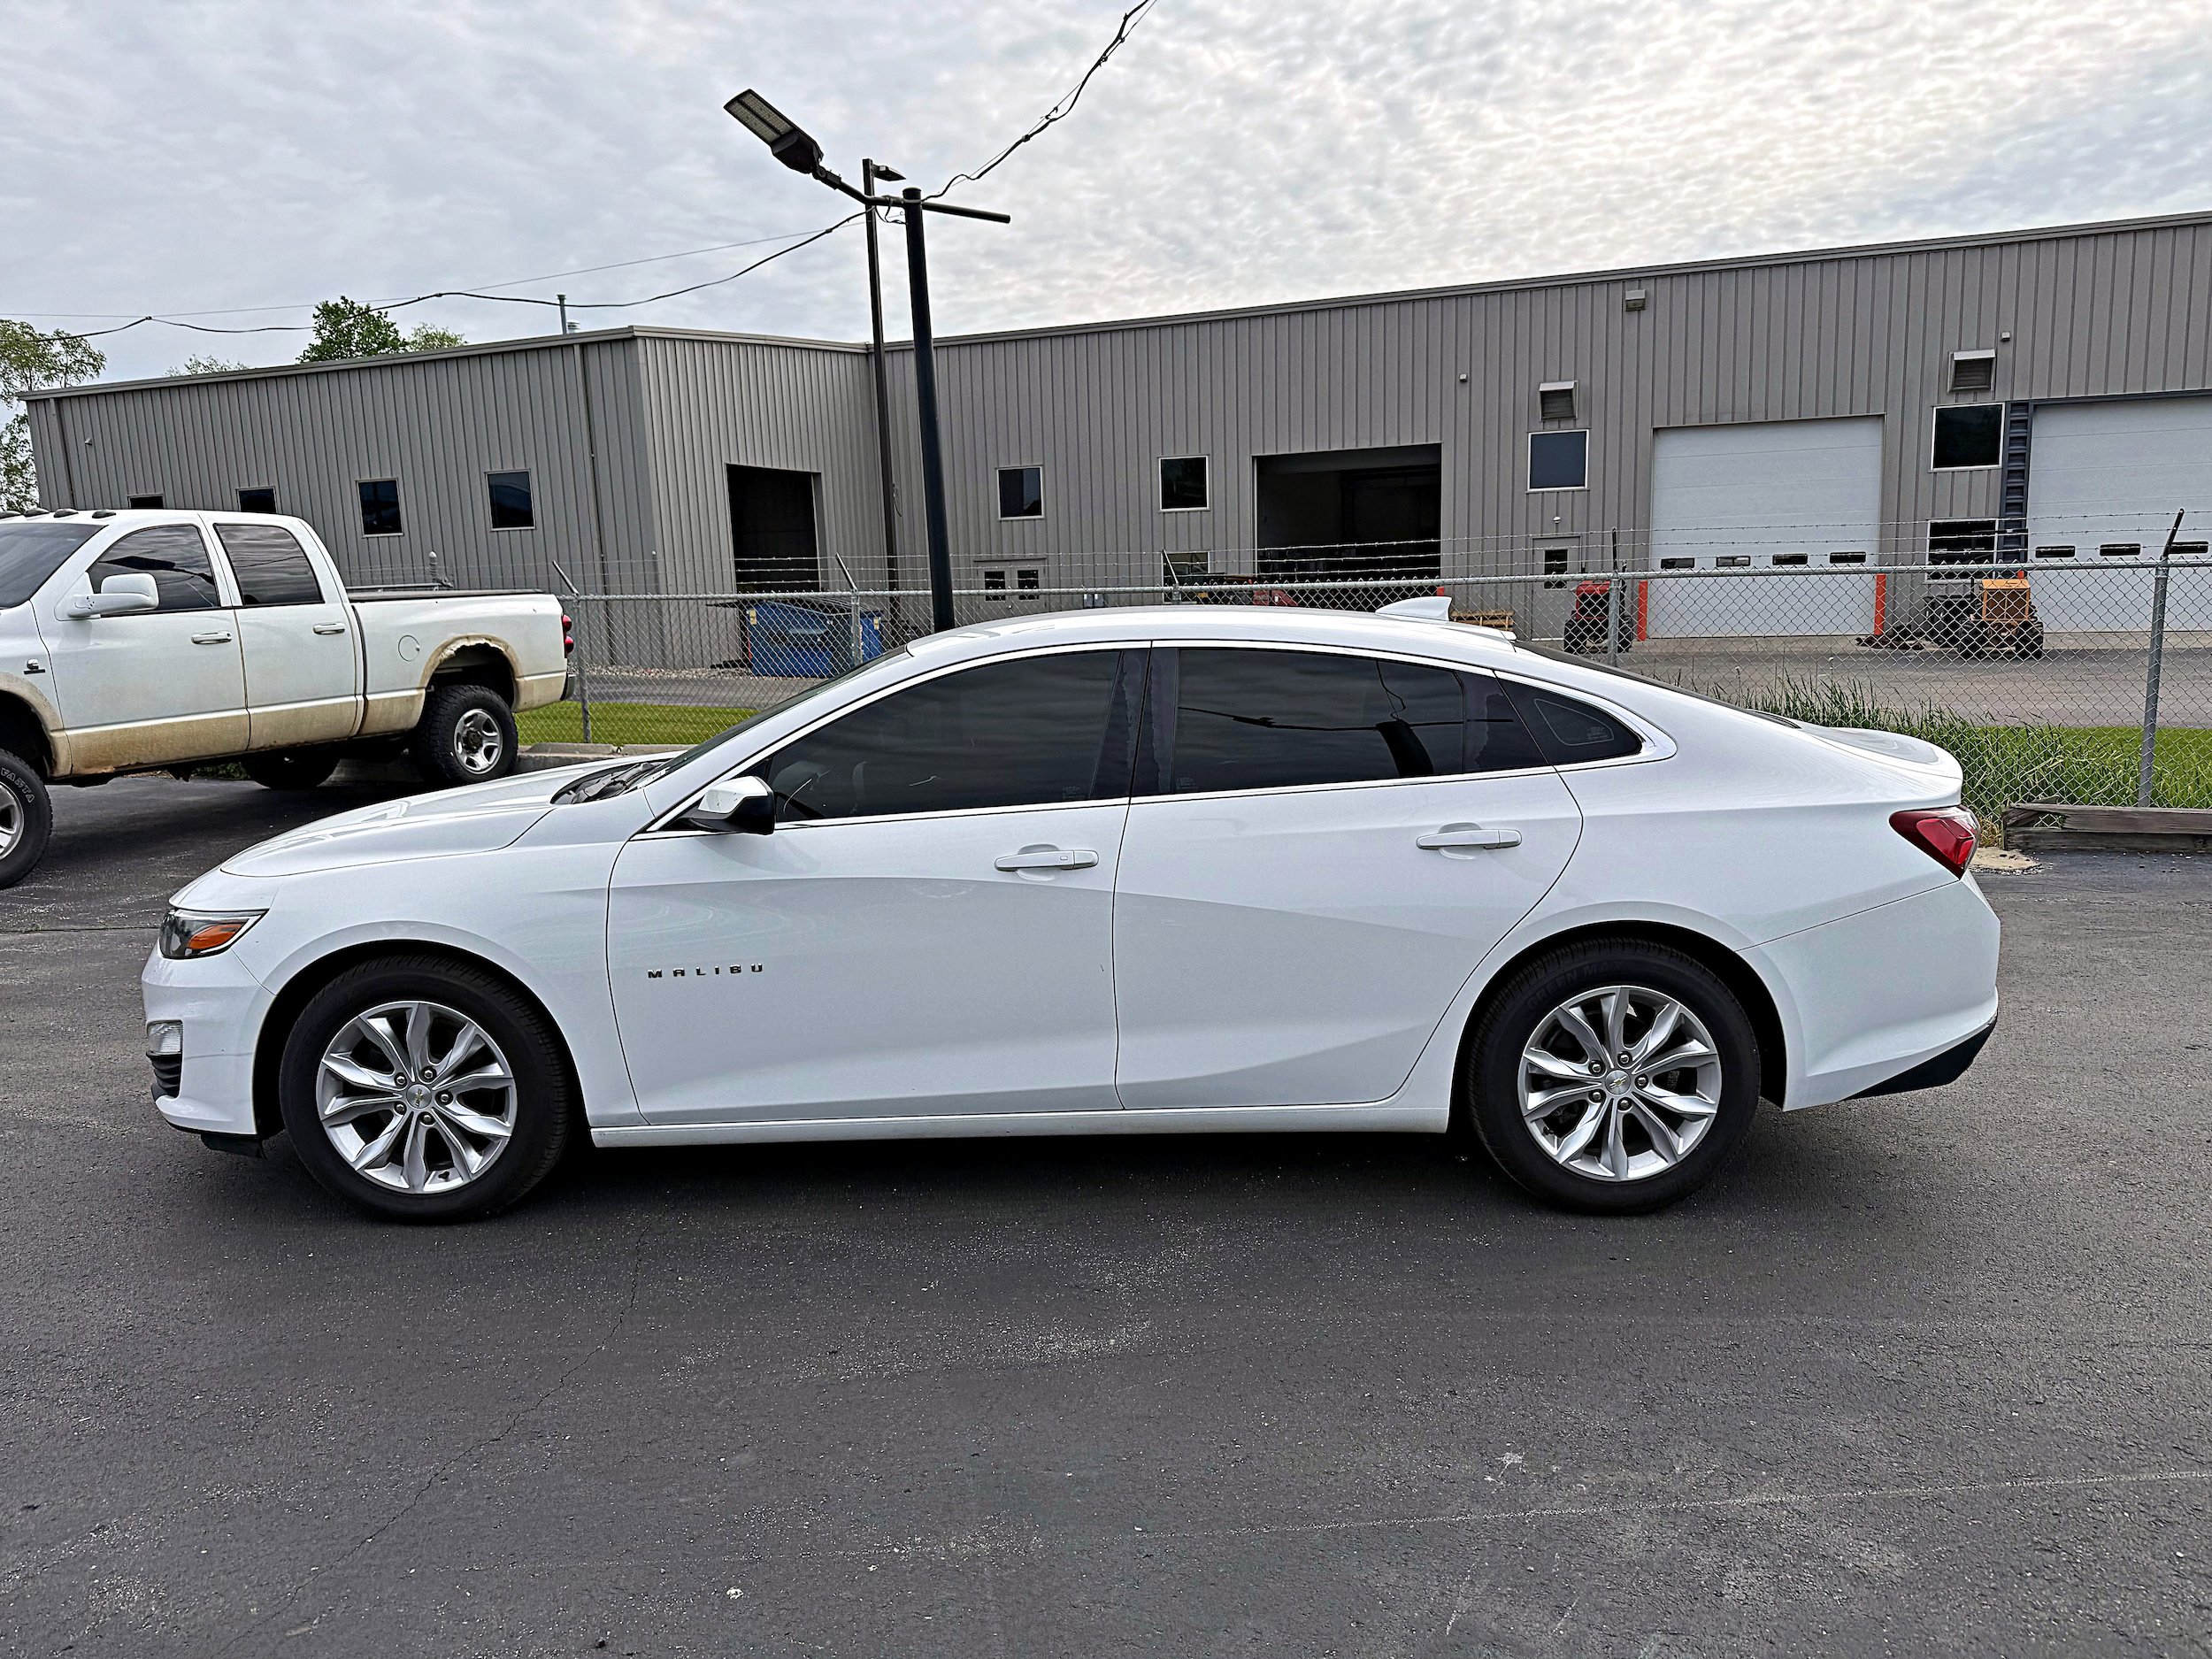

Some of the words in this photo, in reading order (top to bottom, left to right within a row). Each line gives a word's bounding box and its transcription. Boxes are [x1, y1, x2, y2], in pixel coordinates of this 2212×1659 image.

[647, 963, 763, 979] MALIBU
[1526, 968, 1579, 1010] GREEN
[1584, 961, 1622, 978] MAX
